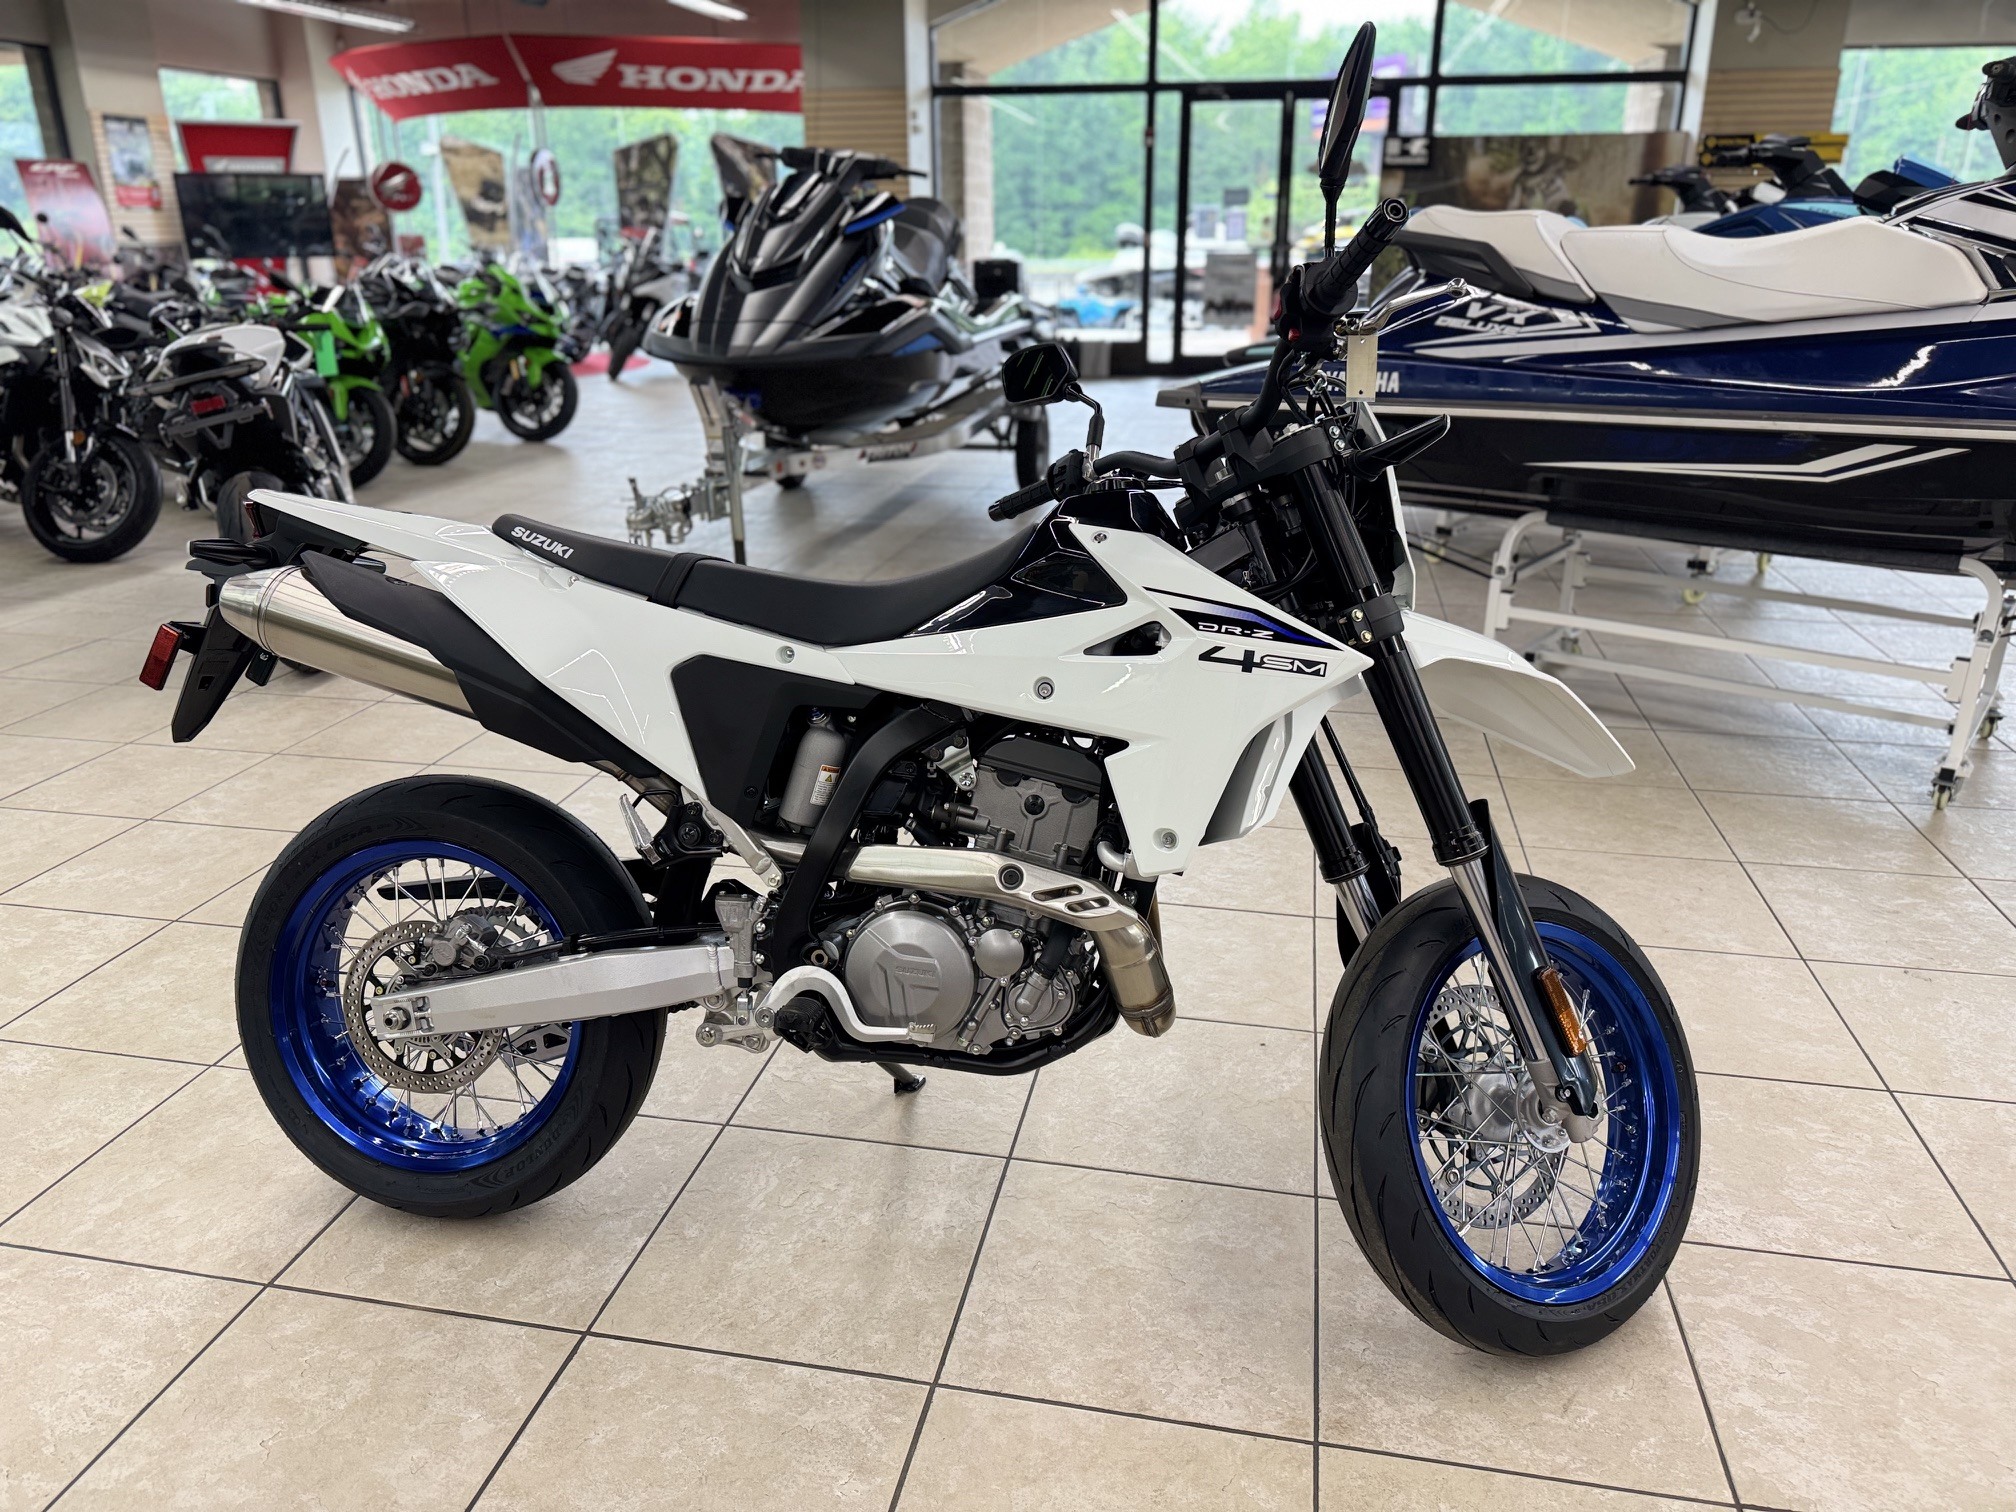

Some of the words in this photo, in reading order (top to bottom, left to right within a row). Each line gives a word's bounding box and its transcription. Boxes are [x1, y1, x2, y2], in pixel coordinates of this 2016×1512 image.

[1466, 301, 1540, 325] VX
[1434, 316, 1519, 336] DELUXE
[511, 526, 574, 559] SUZUKI
[1198, 622, 1274, 639] DR-Z
